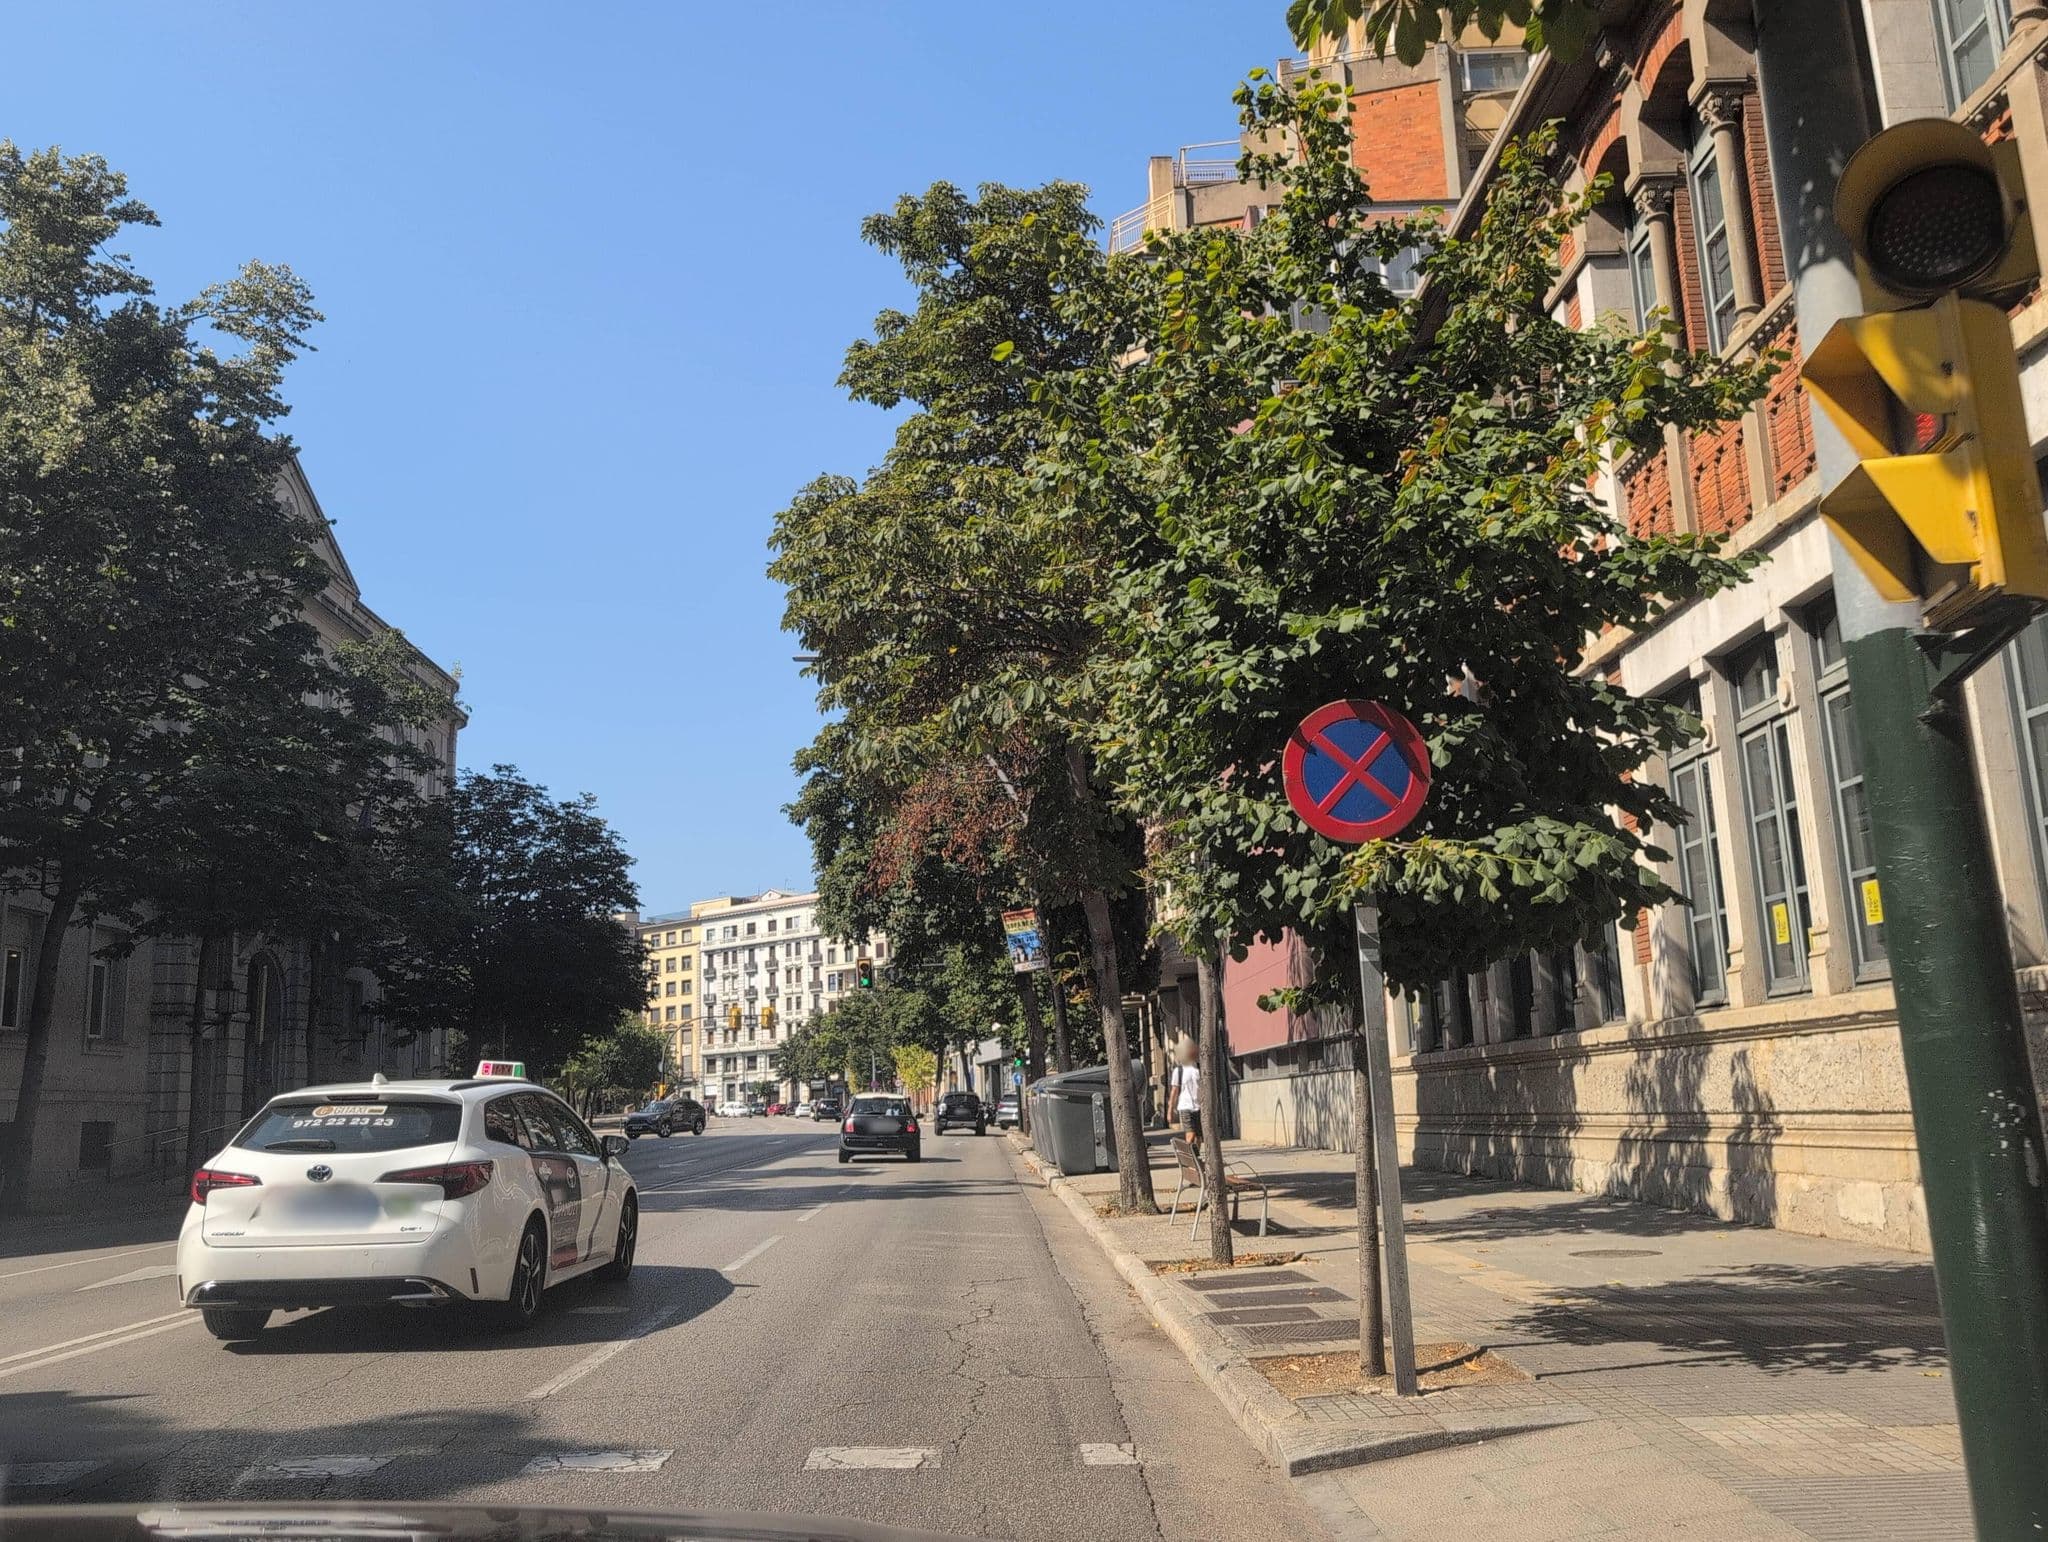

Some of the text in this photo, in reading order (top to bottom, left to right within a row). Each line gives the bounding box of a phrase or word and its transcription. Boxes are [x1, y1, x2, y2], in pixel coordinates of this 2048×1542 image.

[292, 1117, 394, 1128] 972 22 23 23
